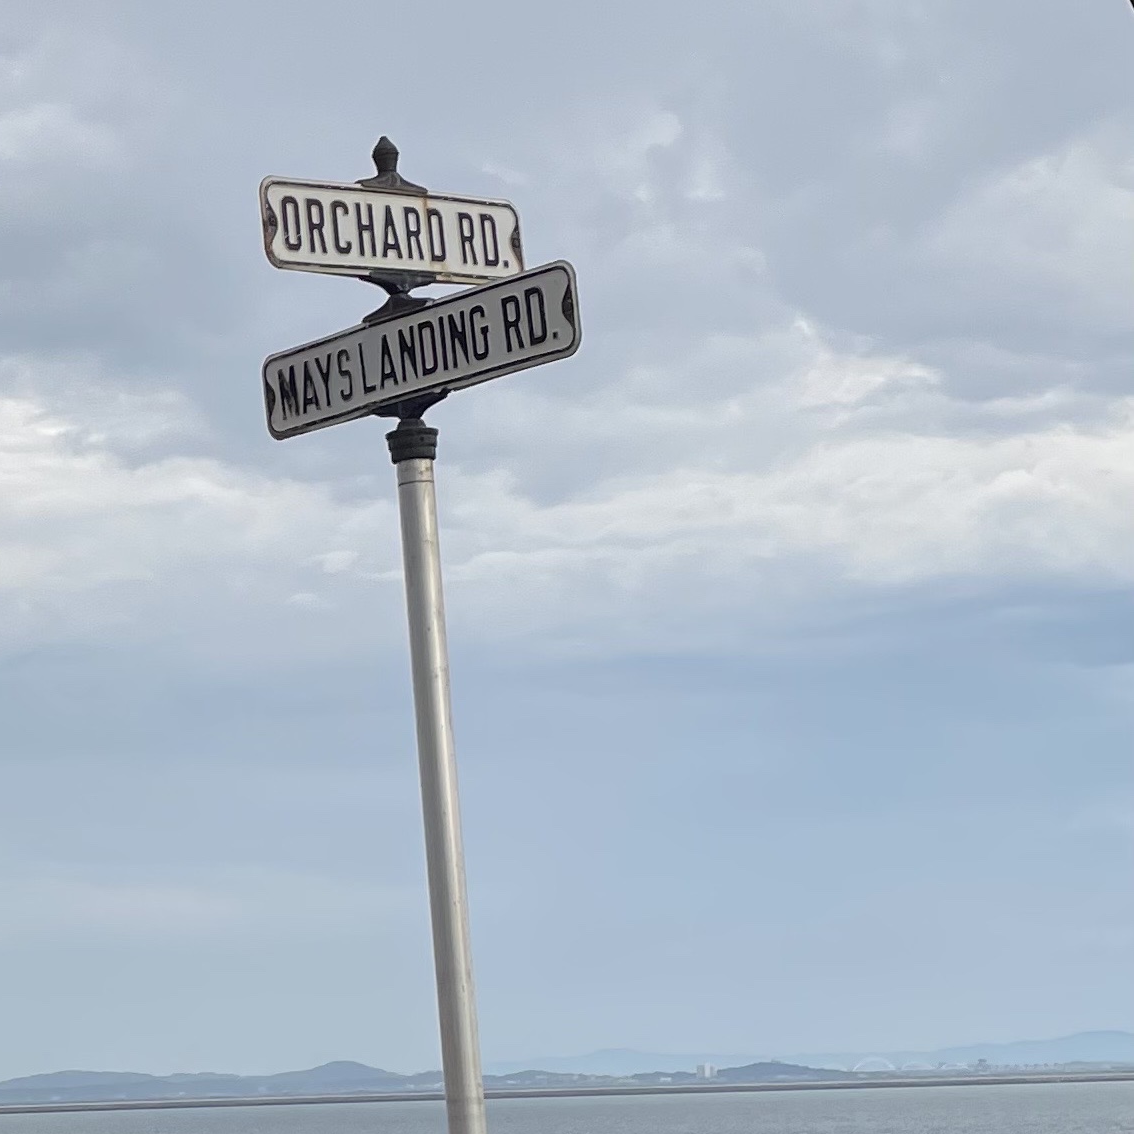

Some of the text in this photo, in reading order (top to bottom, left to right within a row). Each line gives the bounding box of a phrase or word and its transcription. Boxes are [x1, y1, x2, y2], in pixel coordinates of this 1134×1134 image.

[280, 195, 510, 268] ORCHARD RD.
[500, 285, 559, 354] RD.
